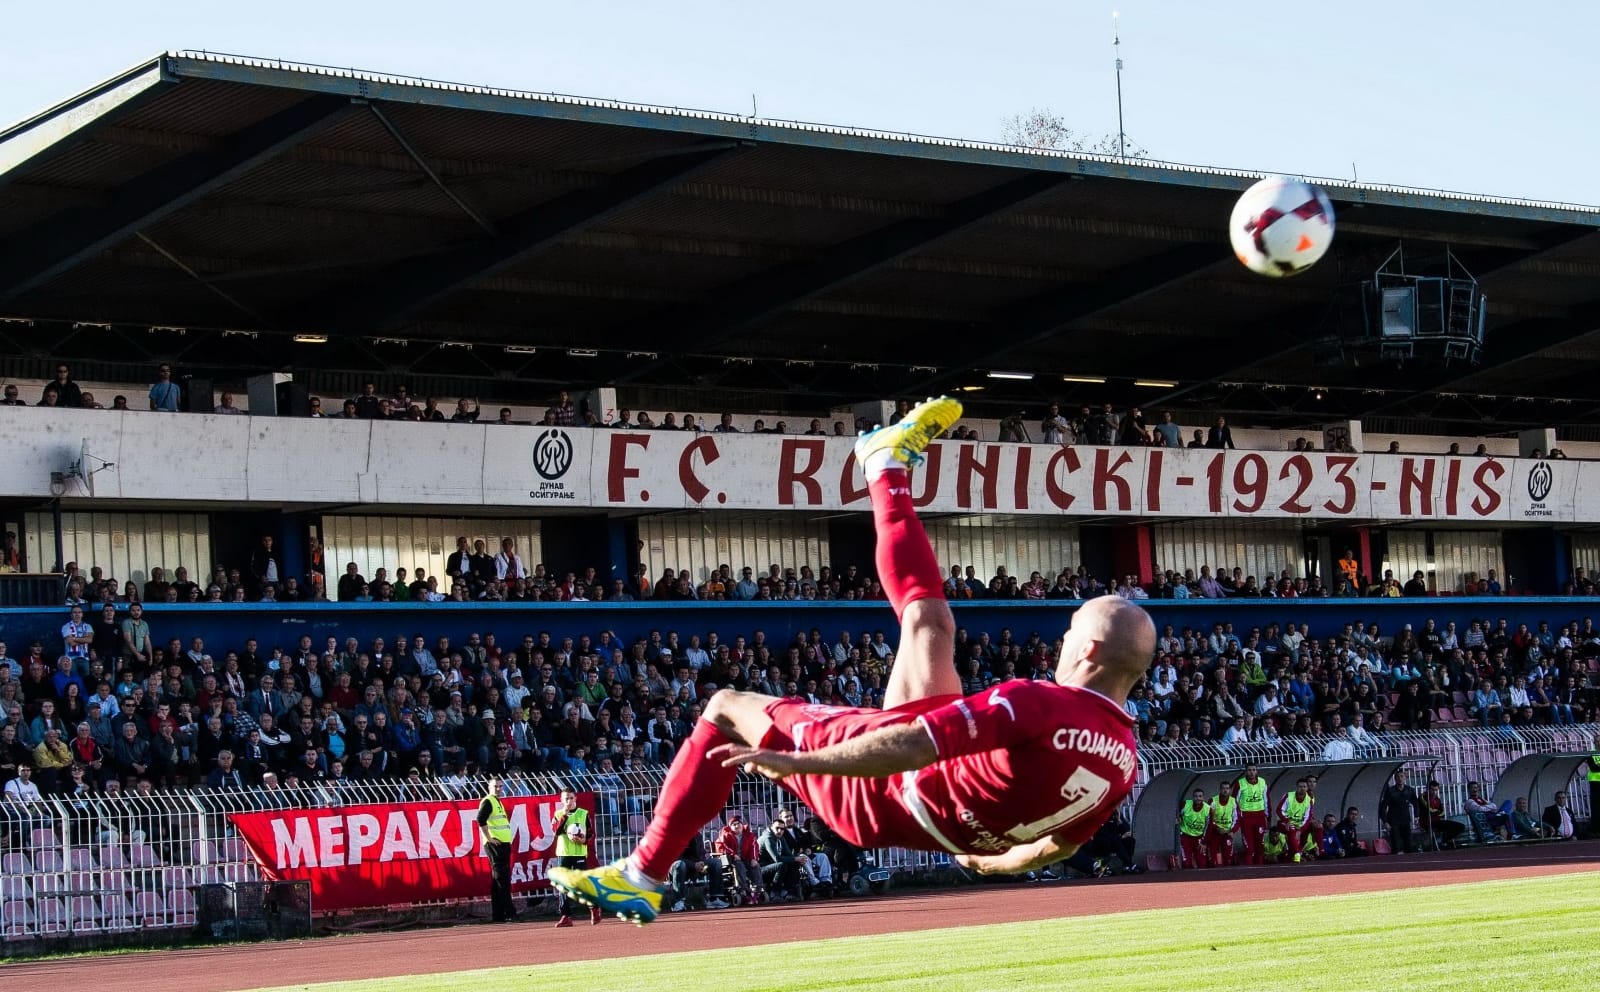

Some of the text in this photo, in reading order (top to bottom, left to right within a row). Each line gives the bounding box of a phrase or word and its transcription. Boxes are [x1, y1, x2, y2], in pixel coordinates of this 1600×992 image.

[529, 491, 575, 499] ОСИГУРАЊЕ
[539, 482, 564, 491] ДУНАВ
[1053, 728, 1136, 784] СТОЈАНОВИ
[1004, 765, 1110, 841] 7
[271, 801, 561, 869] МЕРАКЛИЈ
